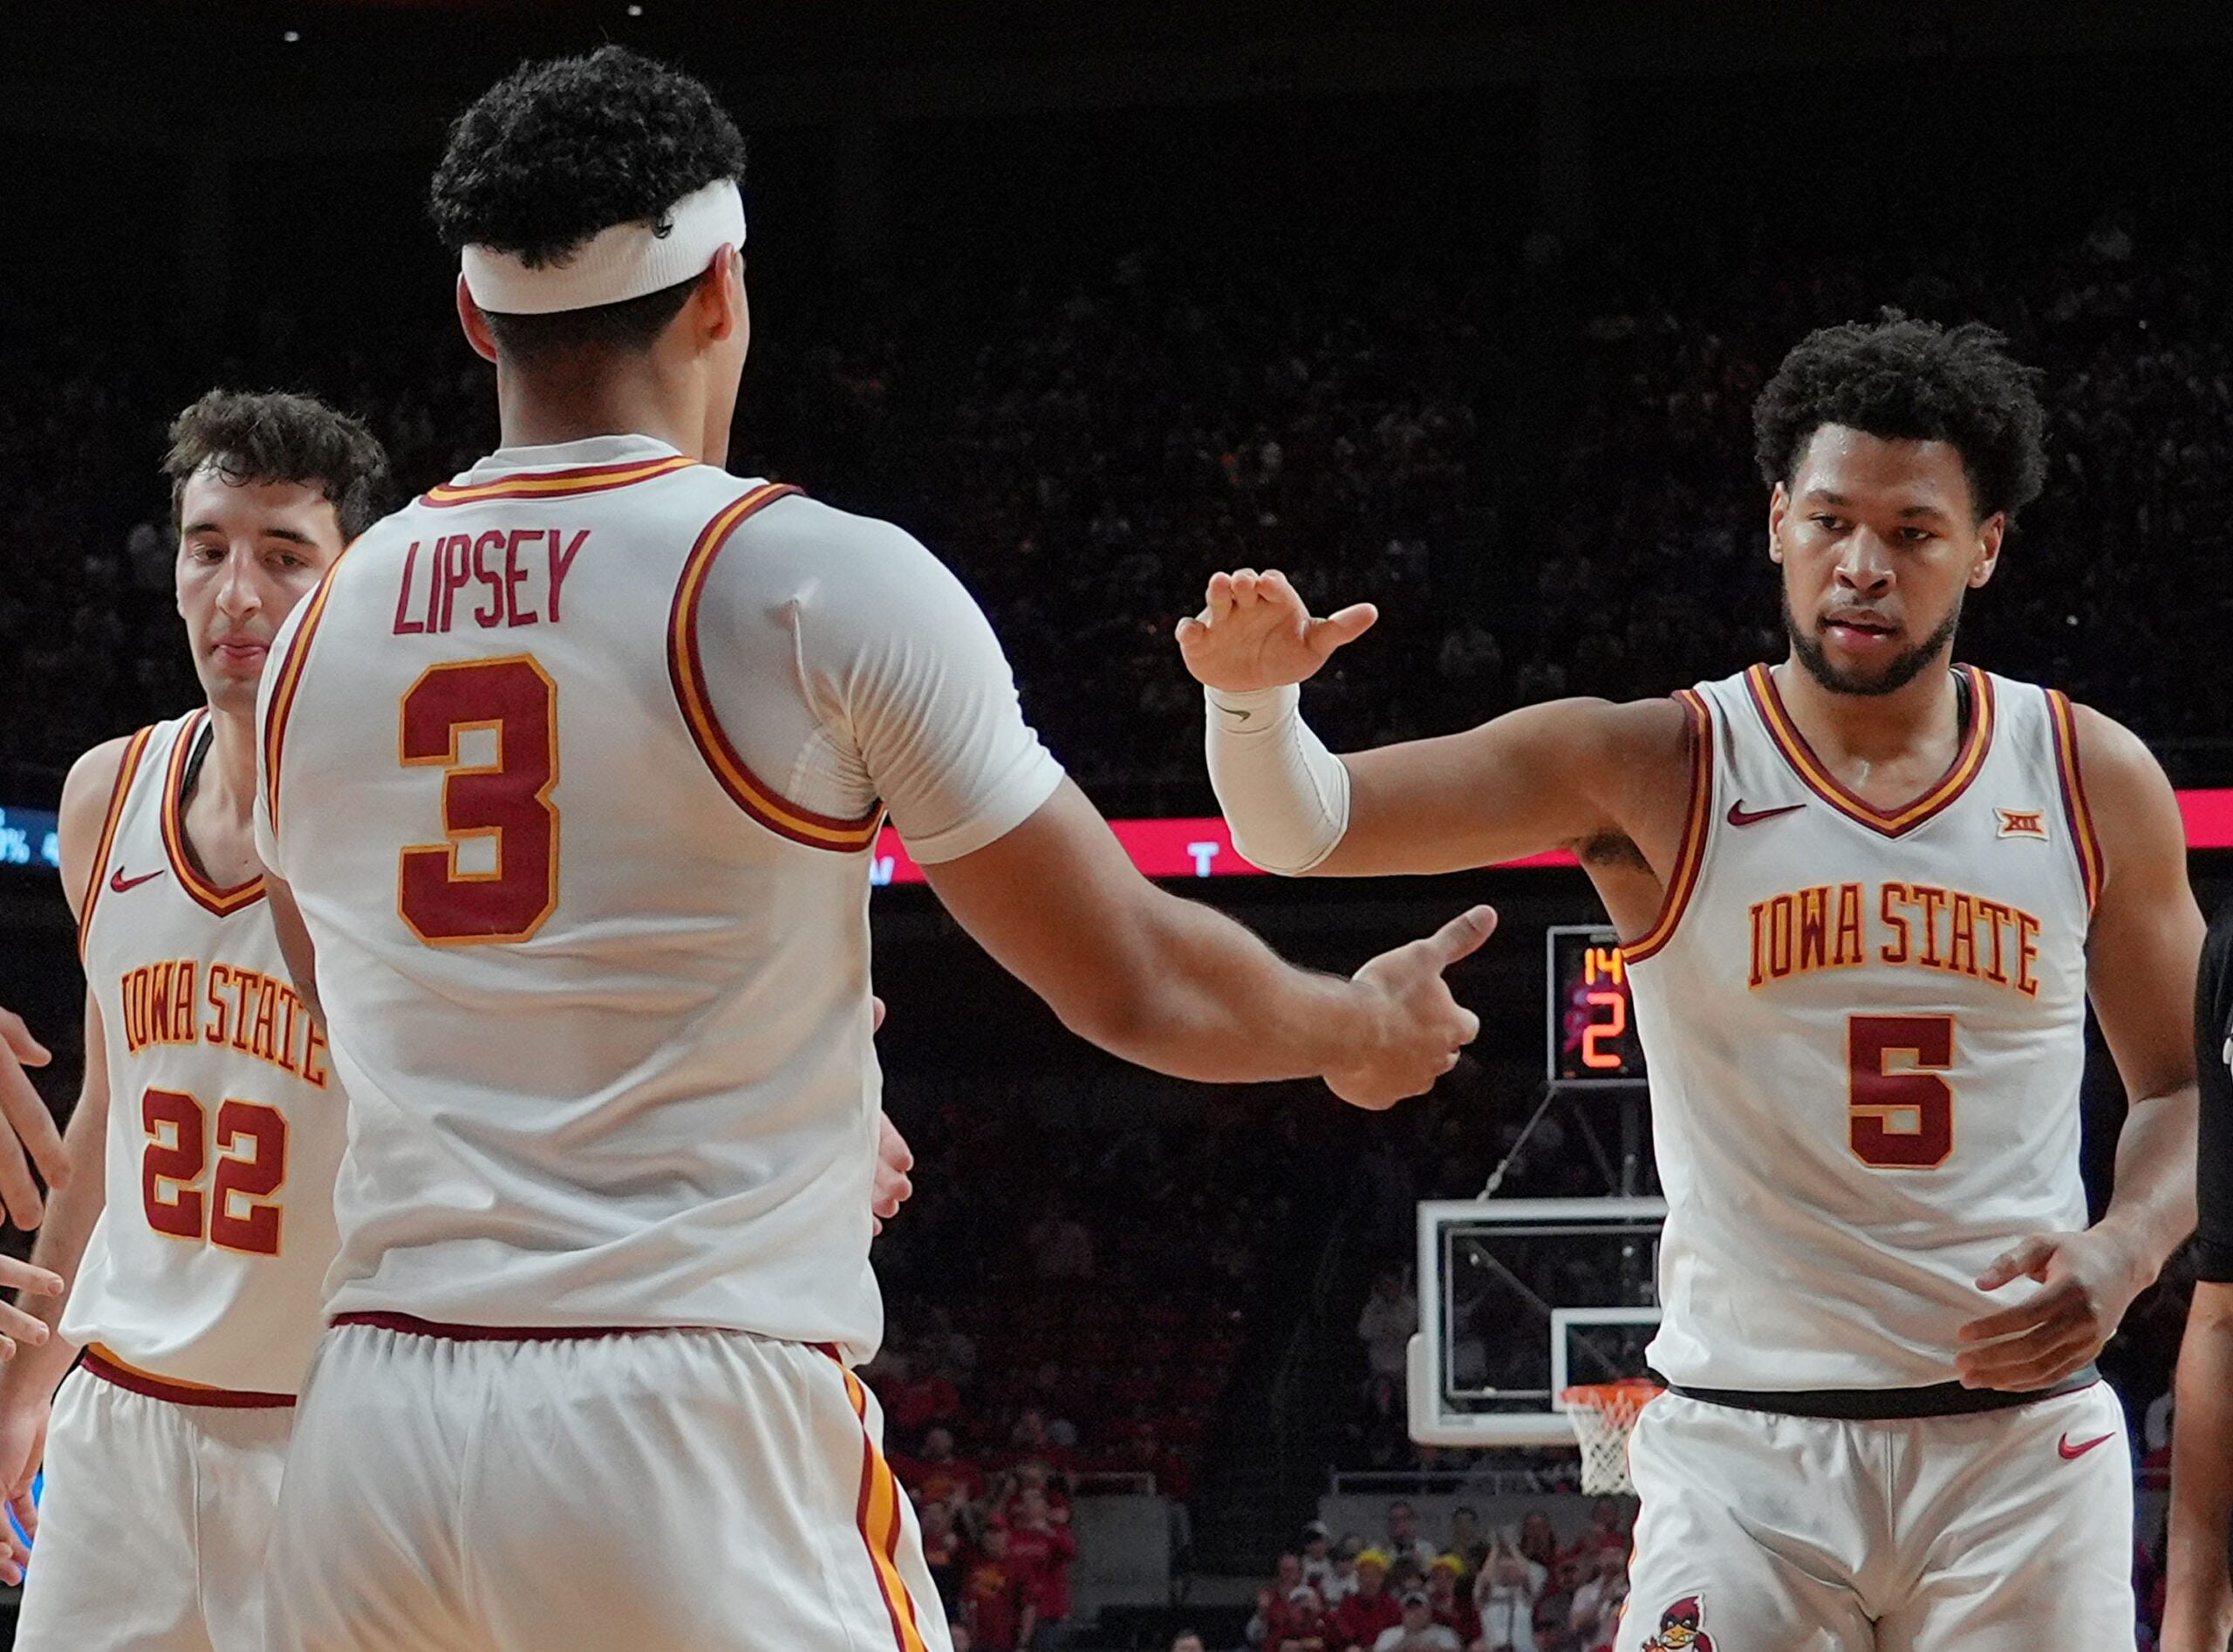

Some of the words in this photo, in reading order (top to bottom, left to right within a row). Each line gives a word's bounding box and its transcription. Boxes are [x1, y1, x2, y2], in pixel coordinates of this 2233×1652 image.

[393, 529, 590, 634] LIPSEY
[399, 653, 558, 944] 3
[1748, 882, 1863, 992] IOWA
[1880, 882, 2041, 999] STATE
[122, 960, 197, 1055] IOWA
[205, 964, 328, 1089] STATE
[1582, 992, 1625, 1068] 2
[1848, 1014, 1955, 1170] 5
[142, 1088, 288, 1257] 22
